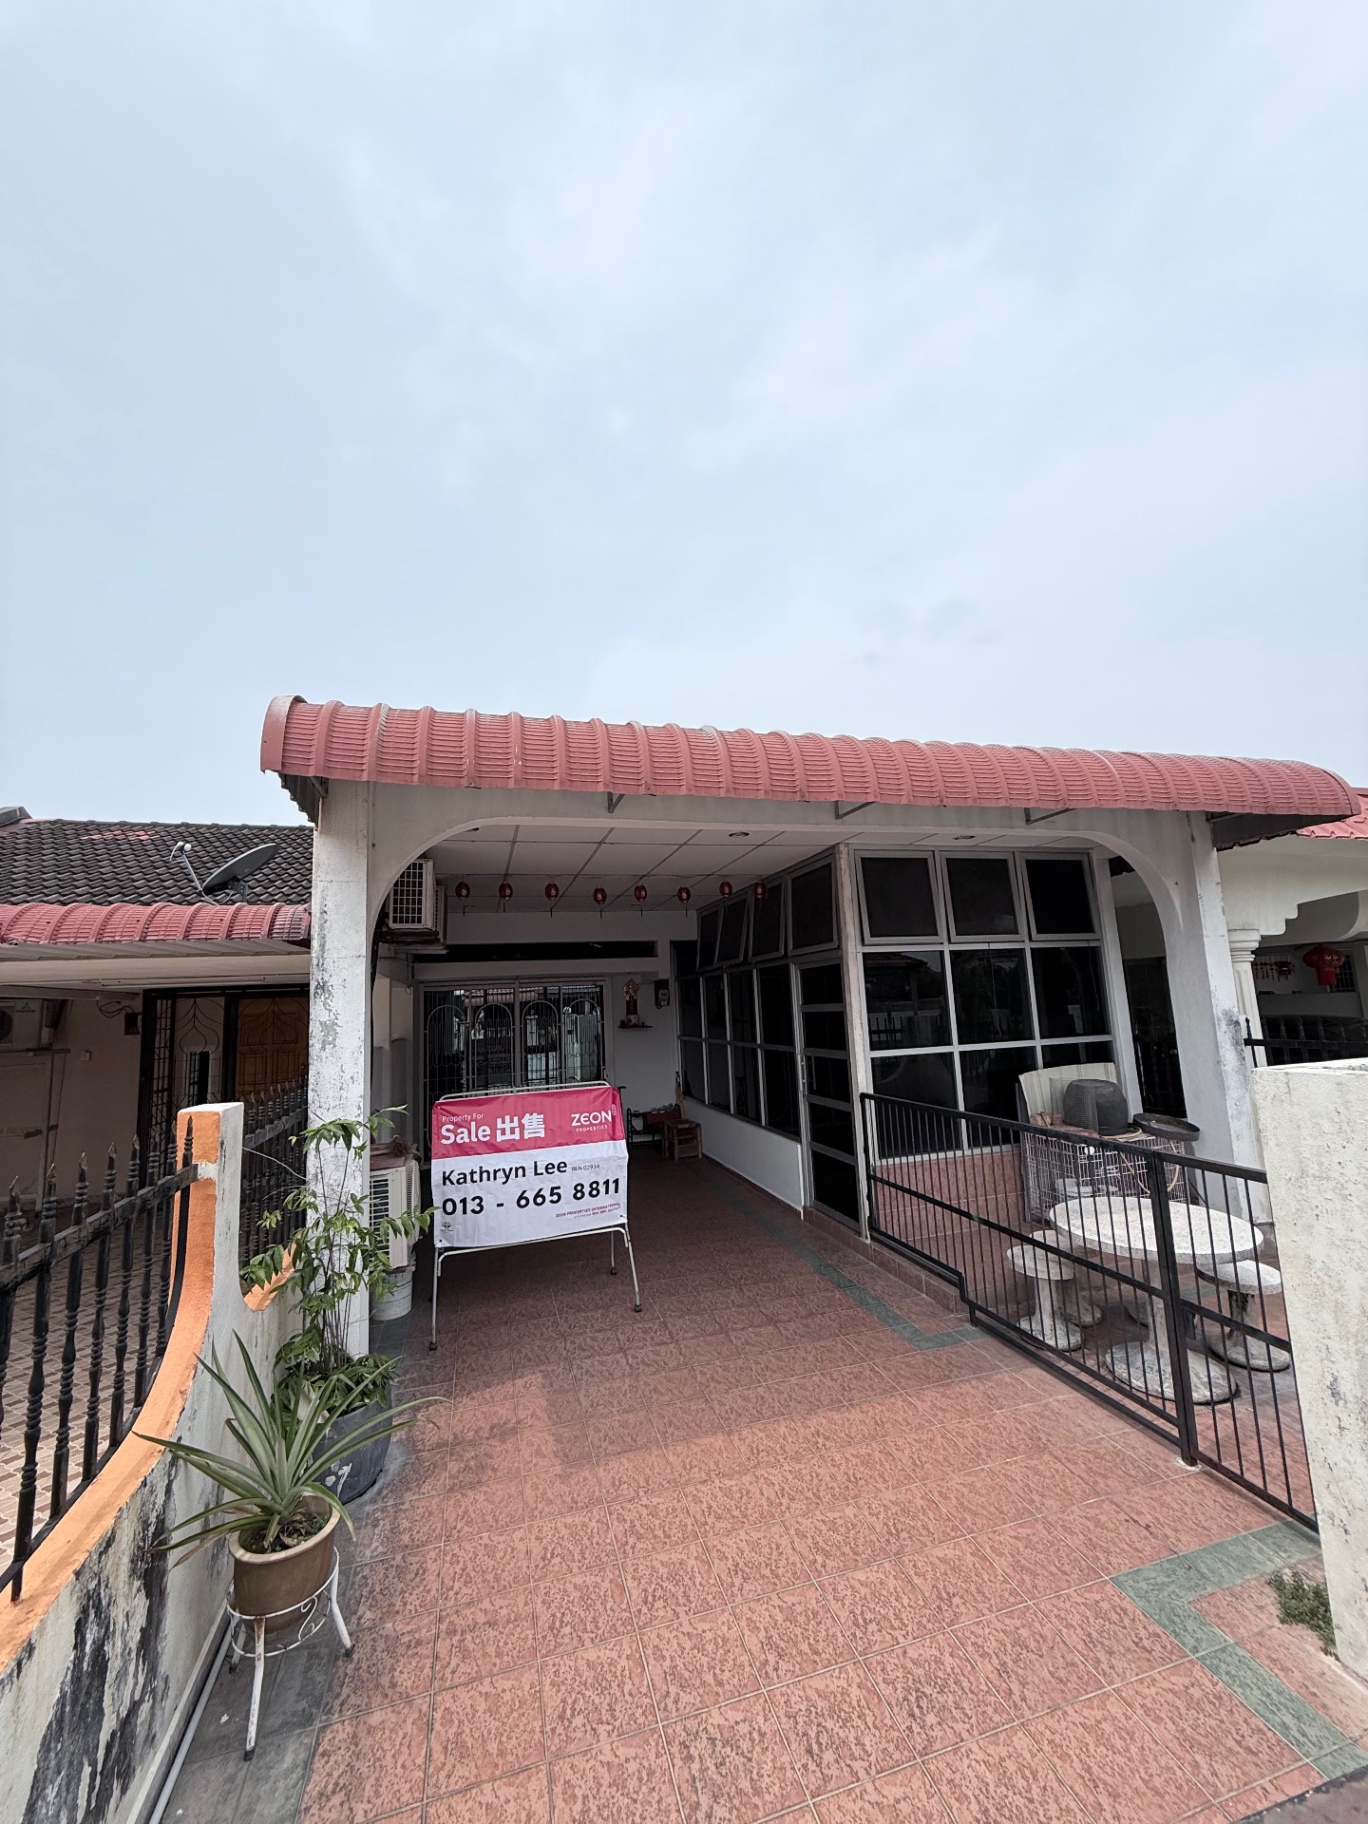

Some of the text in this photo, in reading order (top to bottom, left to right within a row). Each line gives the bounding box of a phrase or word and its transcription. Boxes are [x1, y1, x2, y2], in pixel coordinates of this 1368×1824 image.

[442, 1114, 471, 1122] Property
[496, 1113, 545, 1142] 出售
[571, 1110, 612, 1126] ZEON
[441, 1122, 491, 1144] Sale
[442, 1161, 568, 1186] Kathryn Lee
[442, 1195, 484, 1216] 013
[516, 1186, 562, 1209] 665
[573, 1178, 619, 1201] 8811
